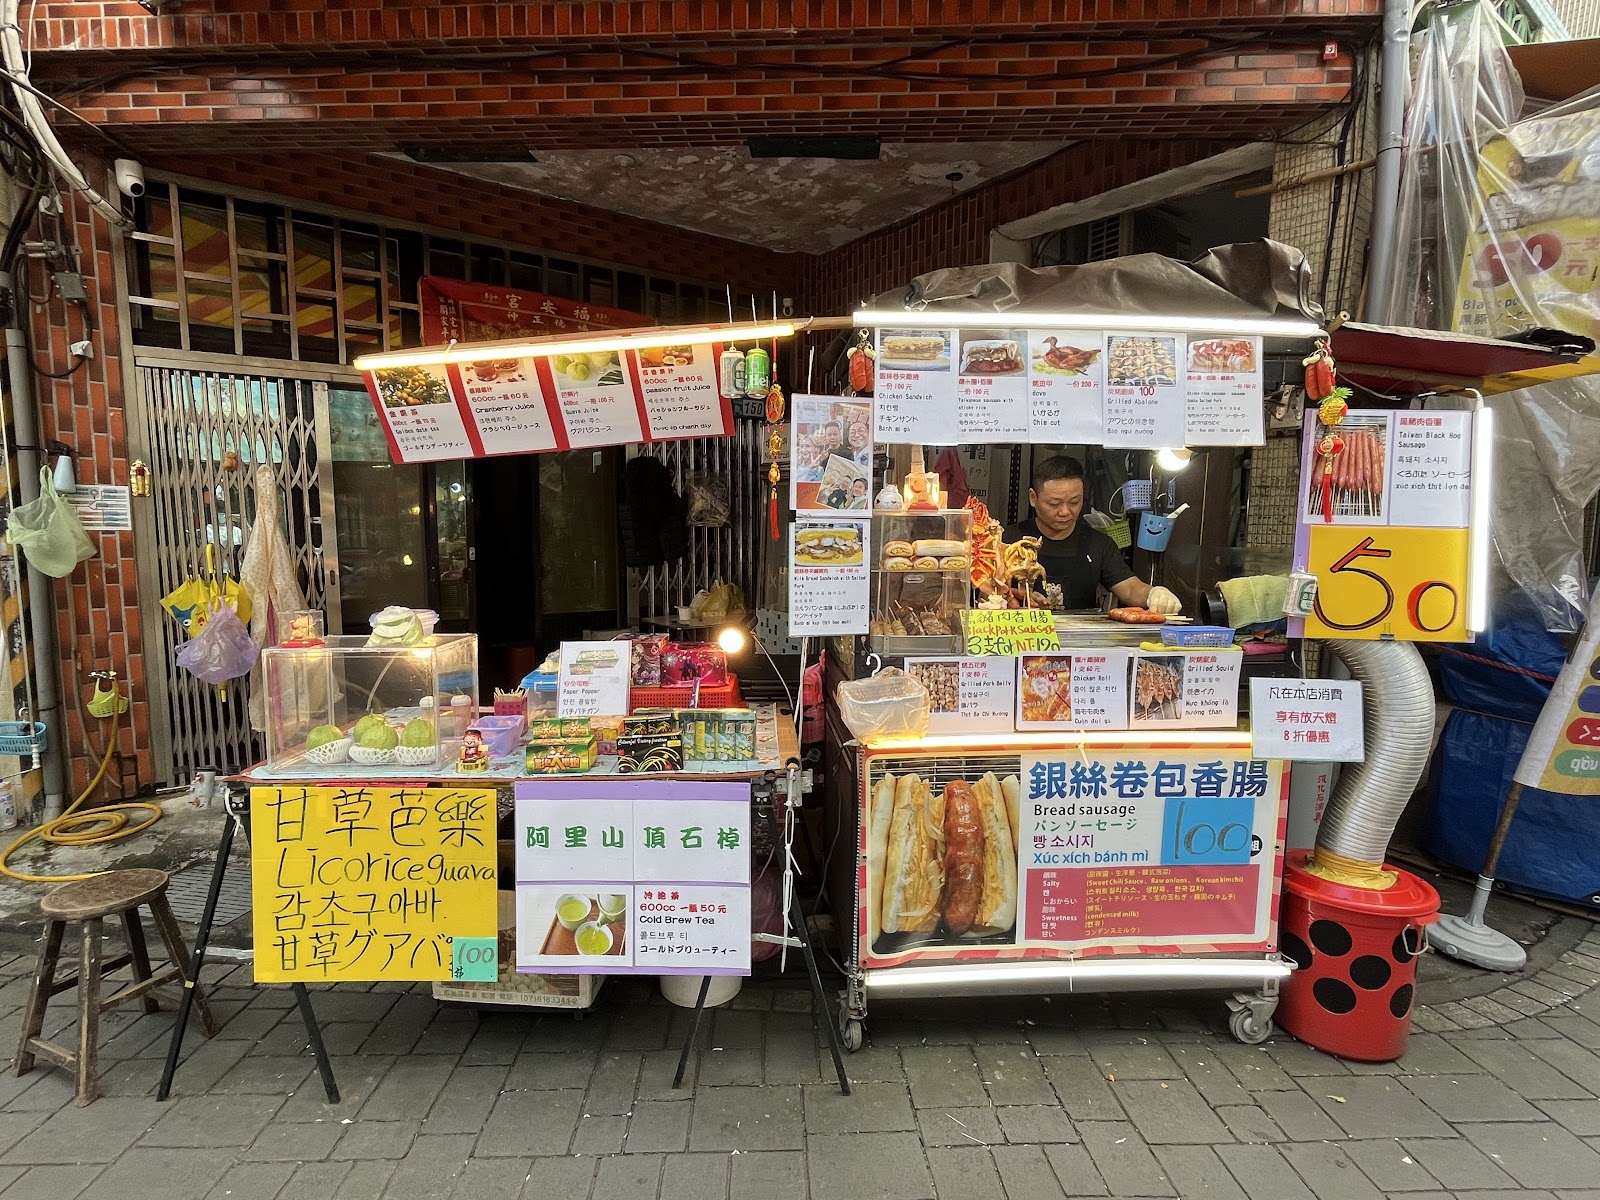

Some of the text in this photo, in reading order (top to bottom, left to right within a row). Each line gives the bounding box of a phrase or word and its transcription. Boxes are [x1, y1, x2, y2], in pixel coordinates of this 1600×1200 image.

[1473, 233, 1563, 288] 50
[1564, 259, 1588, 276] 元
[673, 385, 692, 393] fruit
[1139, 386, 1155, 396] 100
[475, 403, 535, 414] Cranberry Juice
[745, 402, 763, 415] 150
[1399, 431, 1461, 440] Taiwan Black Hog
[1398, 441, 1426, 449] Sausage
[1424, 456, 1448, 465] 소시지
[1313, 536, 1458, 633] 50
[1269, 687, 1343, 700] 凡在本店消費
[1276, 711, 1337, 724] 享有放天燈
[1028, 760, 1269, 799] 銀絲卷包香腸
[1034, 803, 1136, 818] Bread sausage
[266, 788, 488, 847] 甘草芭樂
[1174, 801, 1250, 860] 100
[1033, 834, 1094, 849] 빵 소시지
[1033, 851, 1060, 864] Xúc
[1062, 851, 1091, 864] xích
[1094, 850, 1129, 863] bánh
[277, 847, 496, 888] Licorice guava
[1043, 880, 1060, 888] Salty
[639, 904, 676, 912] 600cc
[639, 915, 715, 925] Cold Brew Tea
[1085, 912, 1121, 921] (condensed
[640, 931, 688, 941] 콜드브루 티
[458, 942, 495, 965] 100
[640, 945, 737, 954] コールドブリューティー
